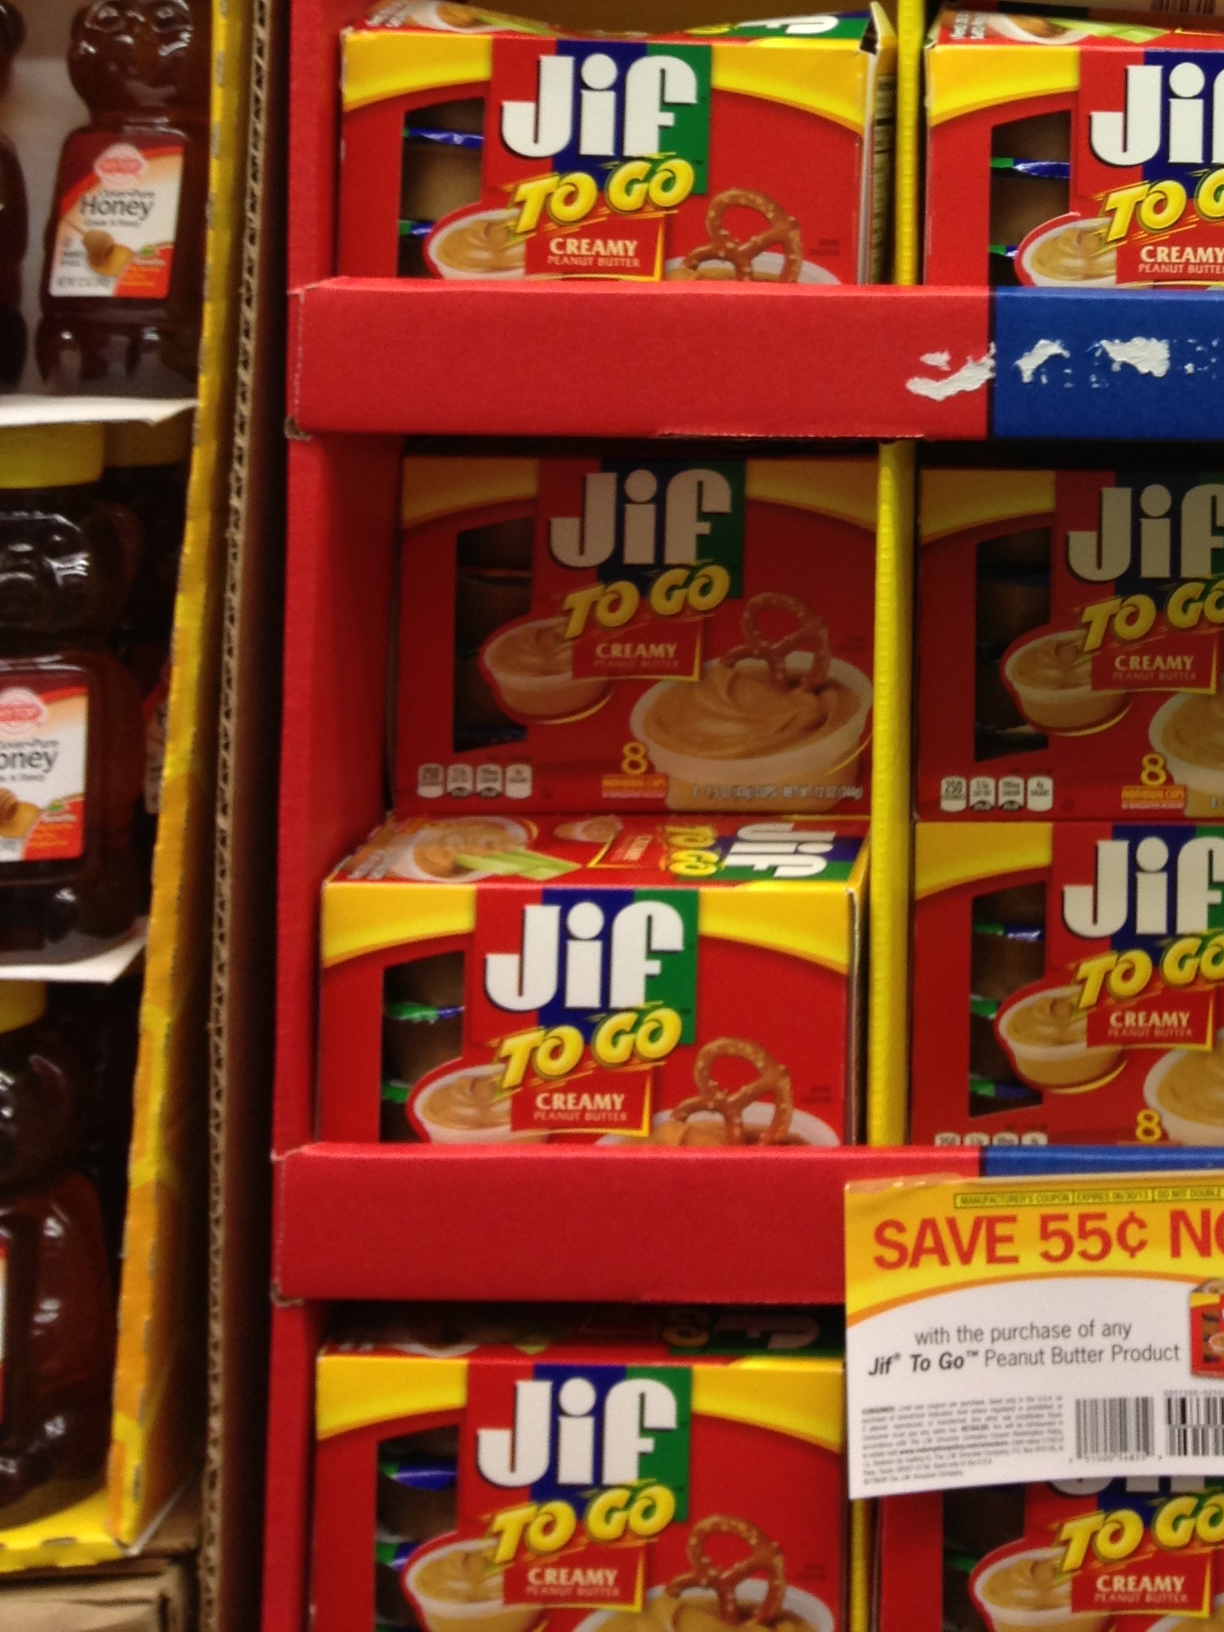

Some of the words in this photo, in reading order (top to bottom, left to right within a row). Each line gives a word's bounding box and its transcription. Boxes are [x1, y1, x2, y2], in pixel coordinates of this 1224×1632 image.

[502, 53, 697, 158] Jif
[80, 195, 156, 222] Honey
[512, 171, 598, 235] TO
[605, 158, 695, 212] GO
[1102, 178, 1187, 243] TO
[549, 237, 637, 257] CREAMY
[1138, 262, 1185, 274] PEANUT
[549, 468, 732, 568] Jif
[561, 580, 640, 641] TO
[649, 564, 731, 617] GO
[1079, 593, 1157, 653] TO
[595, 642, 678, 659] CREAMY
[1114, 654, 1195, 671] CREAMY
[621, 742, 648, 775] 8
[1140, 752, 1167, 786] 8
[485, 900, 685, 1011] Jif
[1075, 948, 1153, 1010] TO
[1109, 1011, 1191, 1028] CREAMY
[498, 1024, 585, 1089] TO
[593, 1007, 682, 1065] GO
[535, 1092, 625, 1112] CREAMY
[1136, 1109, 1162, 1143] 8
[873, 1214, 1020, 1271] SAVE
[1037, 1210, 1149, 1264] 55¢
[914, 1325, 953, 1346] with
[957, 1324, 984, 1343] the
[990, 1320, 1072, 1345] purchase
[1077, 1319, 1097, 1338] of
[1101, 1322, 1132, 1342] any
[910, 1353, 932, 1373] To
[984, 1348, 1048, 1369] Peanut
[1053, 1346, 1104, 1366] Butter
[1111, 1344, 1181, 1365] Product
[477, 1377, 678, 1488] Jif
[491, 1500, 577, 1564] TO
[585, 1483, 676, 1542] GO
[1057, 1508, 1145, 1572] TO
[527, 1567, 618, 1586] CREAMY
[1095, 1574, 1186, 1593] CREAMY
